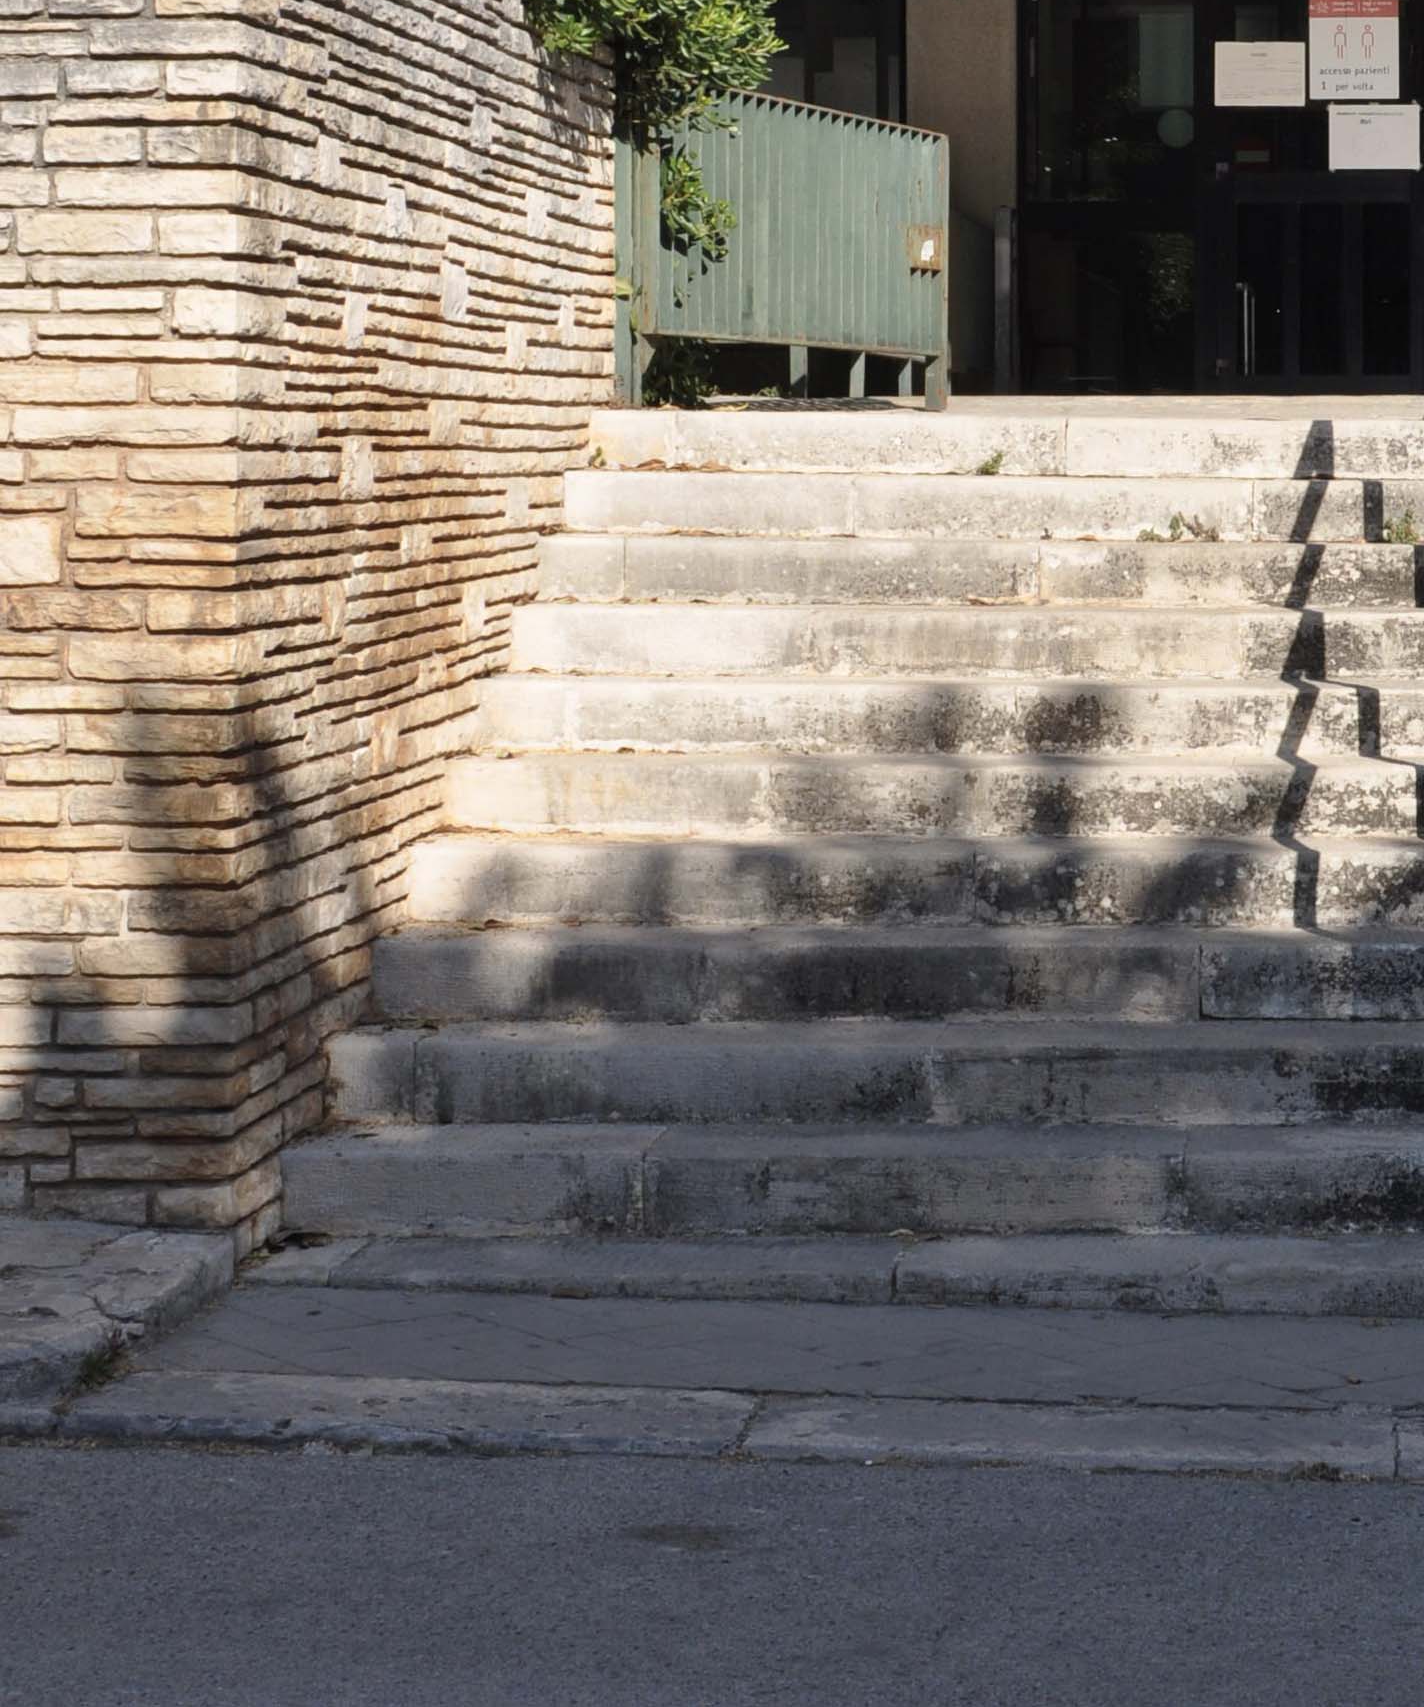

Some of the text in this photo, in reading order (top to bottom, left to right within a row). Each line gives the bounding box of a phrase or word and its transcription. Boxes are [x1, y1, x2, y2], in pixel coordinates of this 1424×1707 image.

[1319, 65, 1391, 78] accesso pazienti
[1335, 83, 1350, 93] per
[1352, 81, 1375, 91] volta
